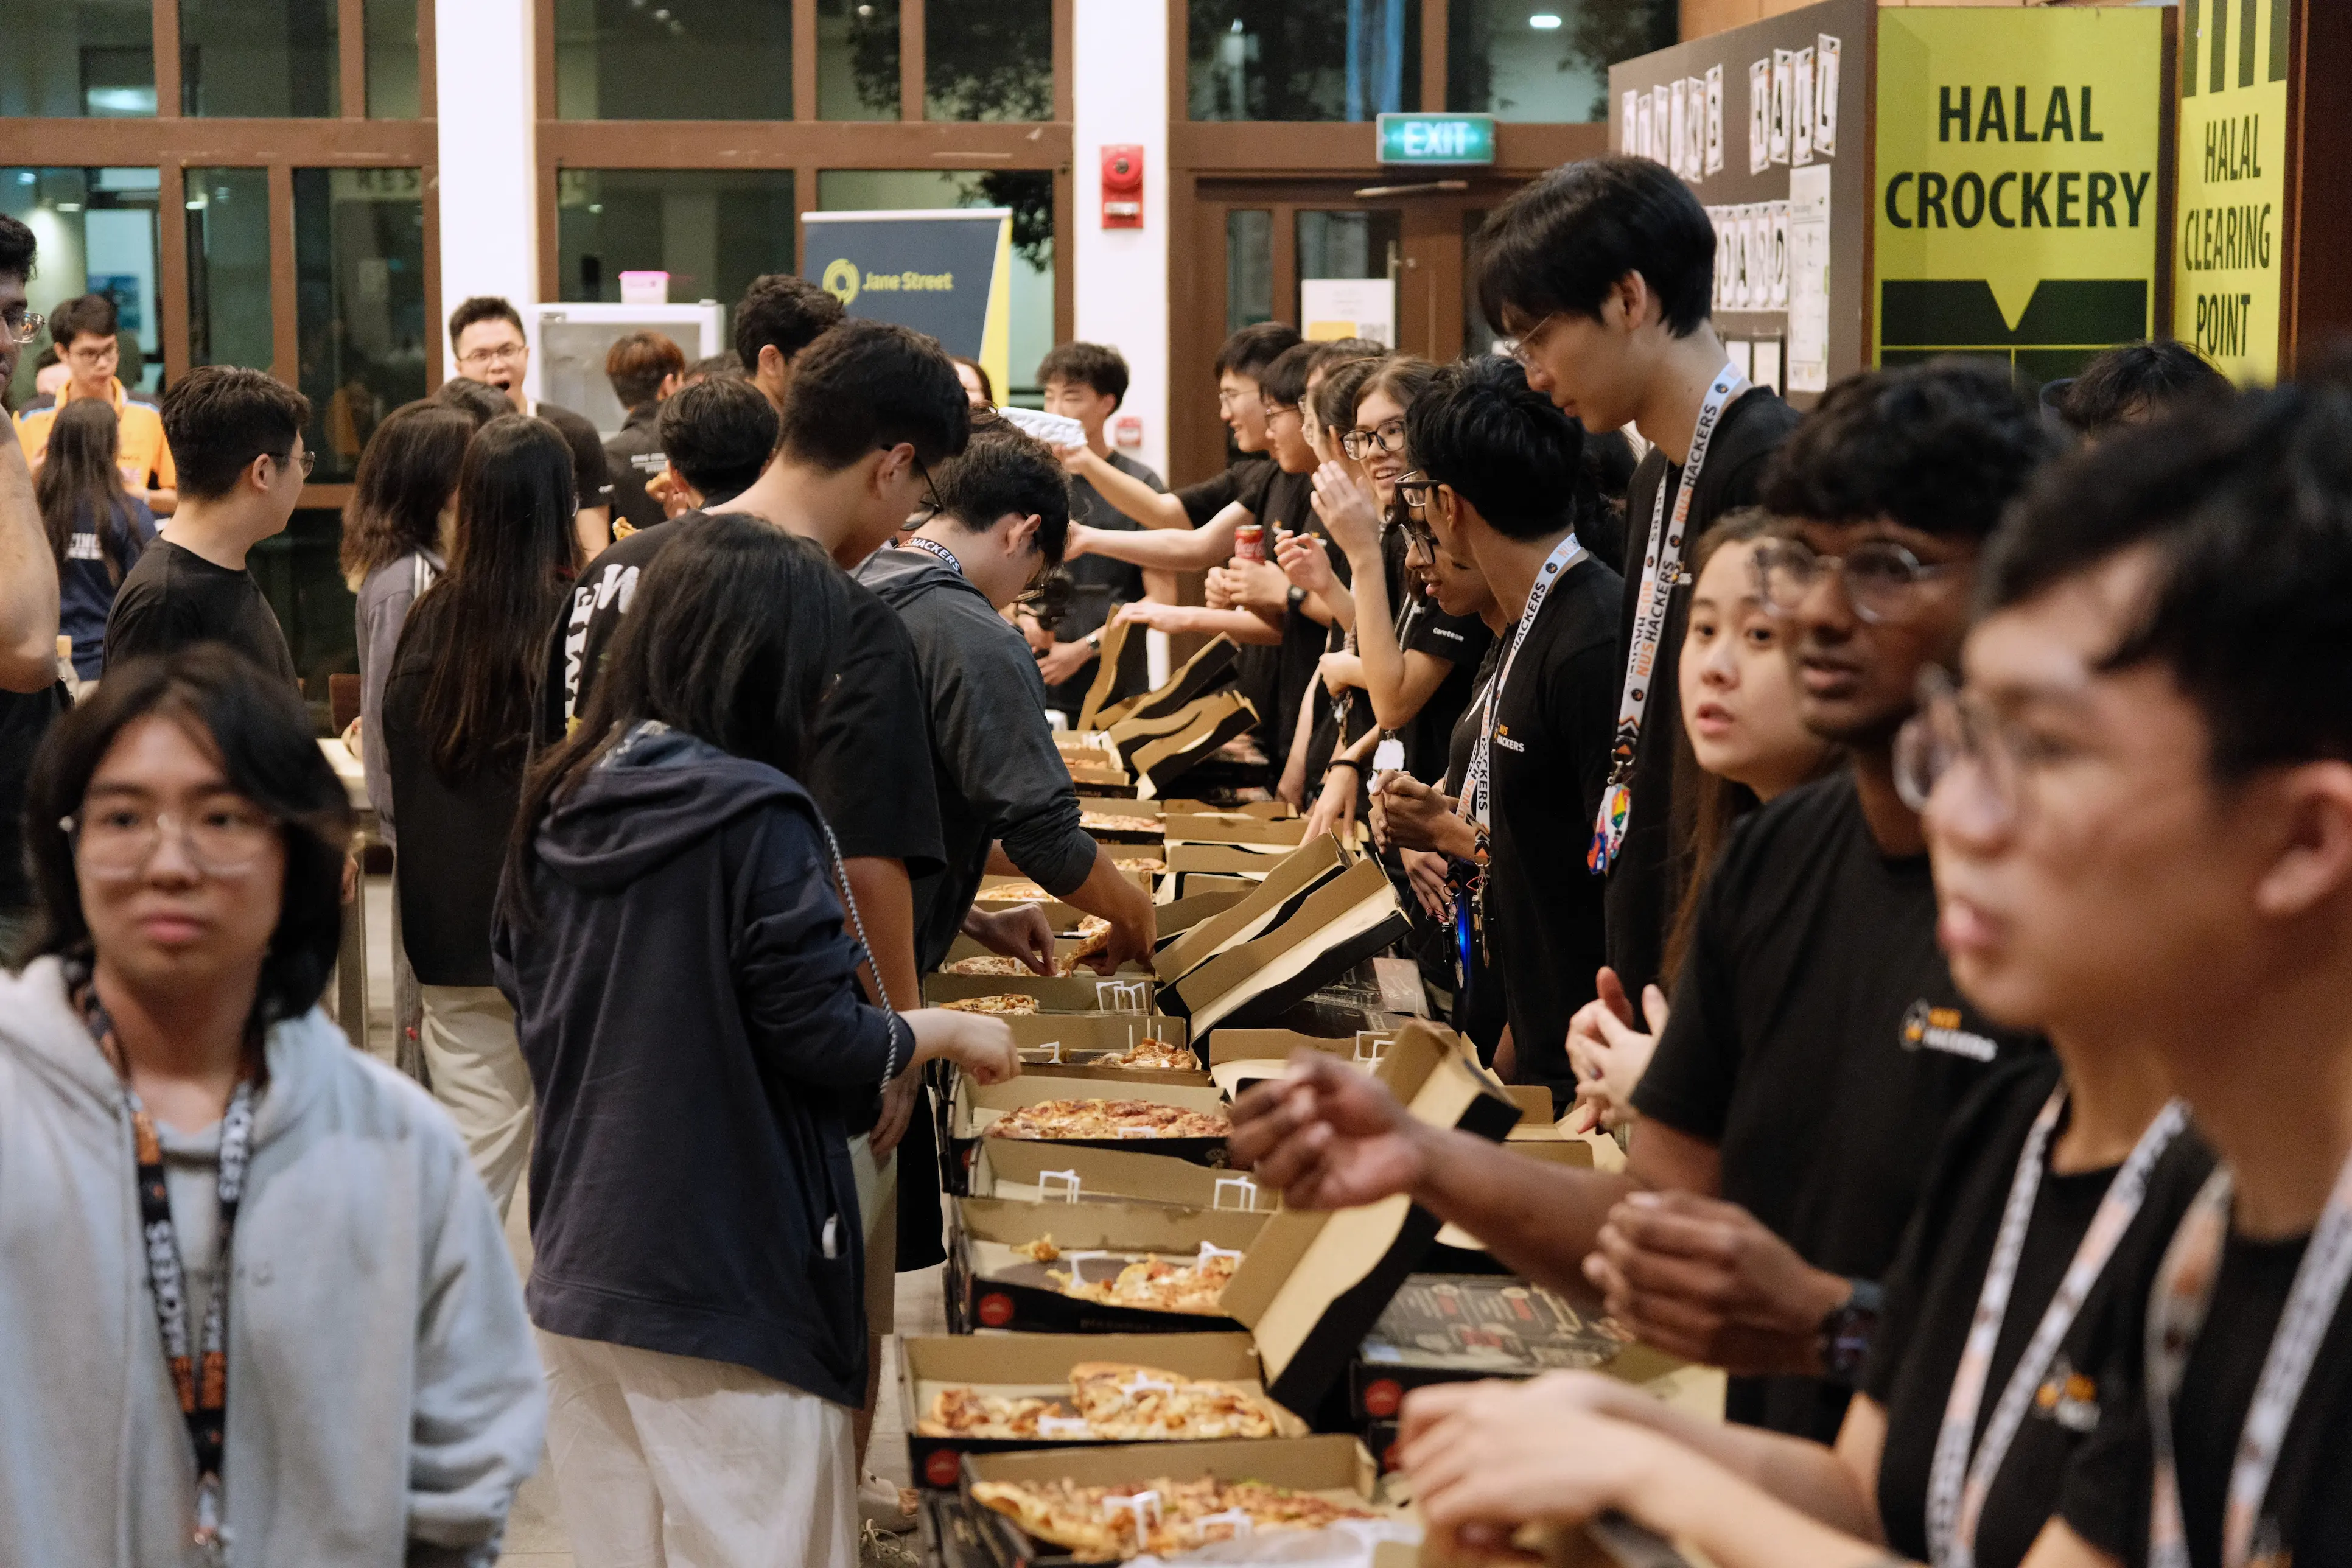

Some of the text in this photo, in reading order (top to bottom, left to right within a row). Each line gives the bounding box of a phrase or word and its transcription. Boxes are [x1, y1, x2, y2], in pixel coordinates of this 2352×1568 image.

[1404, 121, 1470, 156] EXIT
[1939, 85, 2104, 142] HALAL
[2204, 113, 2262, 184] HALAL
[1885, 171, 2151, 228] CROCKERY
[2184, 203, 2272, 271] CLEARING
[862, 271, 954, 291] Jane Street
[2197, 293, 2251, 357] POINT
